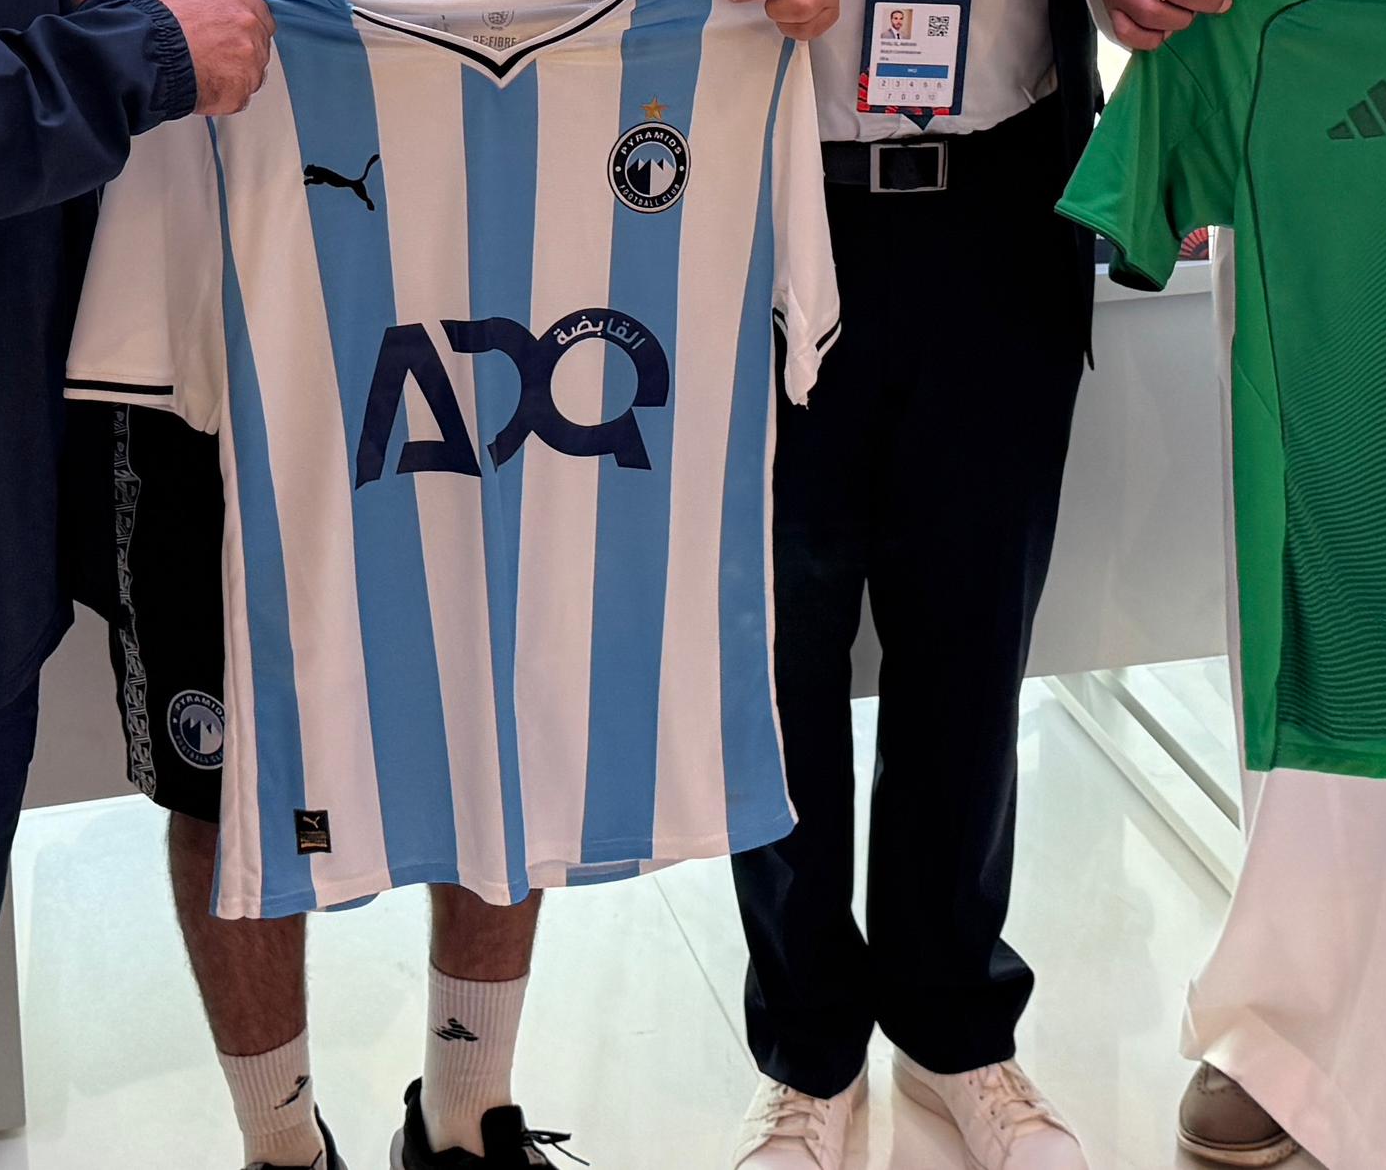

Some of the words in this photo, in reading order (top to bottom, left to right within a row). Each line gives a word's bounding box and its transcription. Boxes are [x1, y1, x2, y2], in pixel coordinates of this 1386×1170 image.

[620, 131, 682, 155] PYRAMIDS
[618, 184, 660, 207] FOOTBALL
[662, 183, 680, 202] CLUB
[553, 315, 646, 350] القابضة
[354, 308, 670, 491] ADQ
